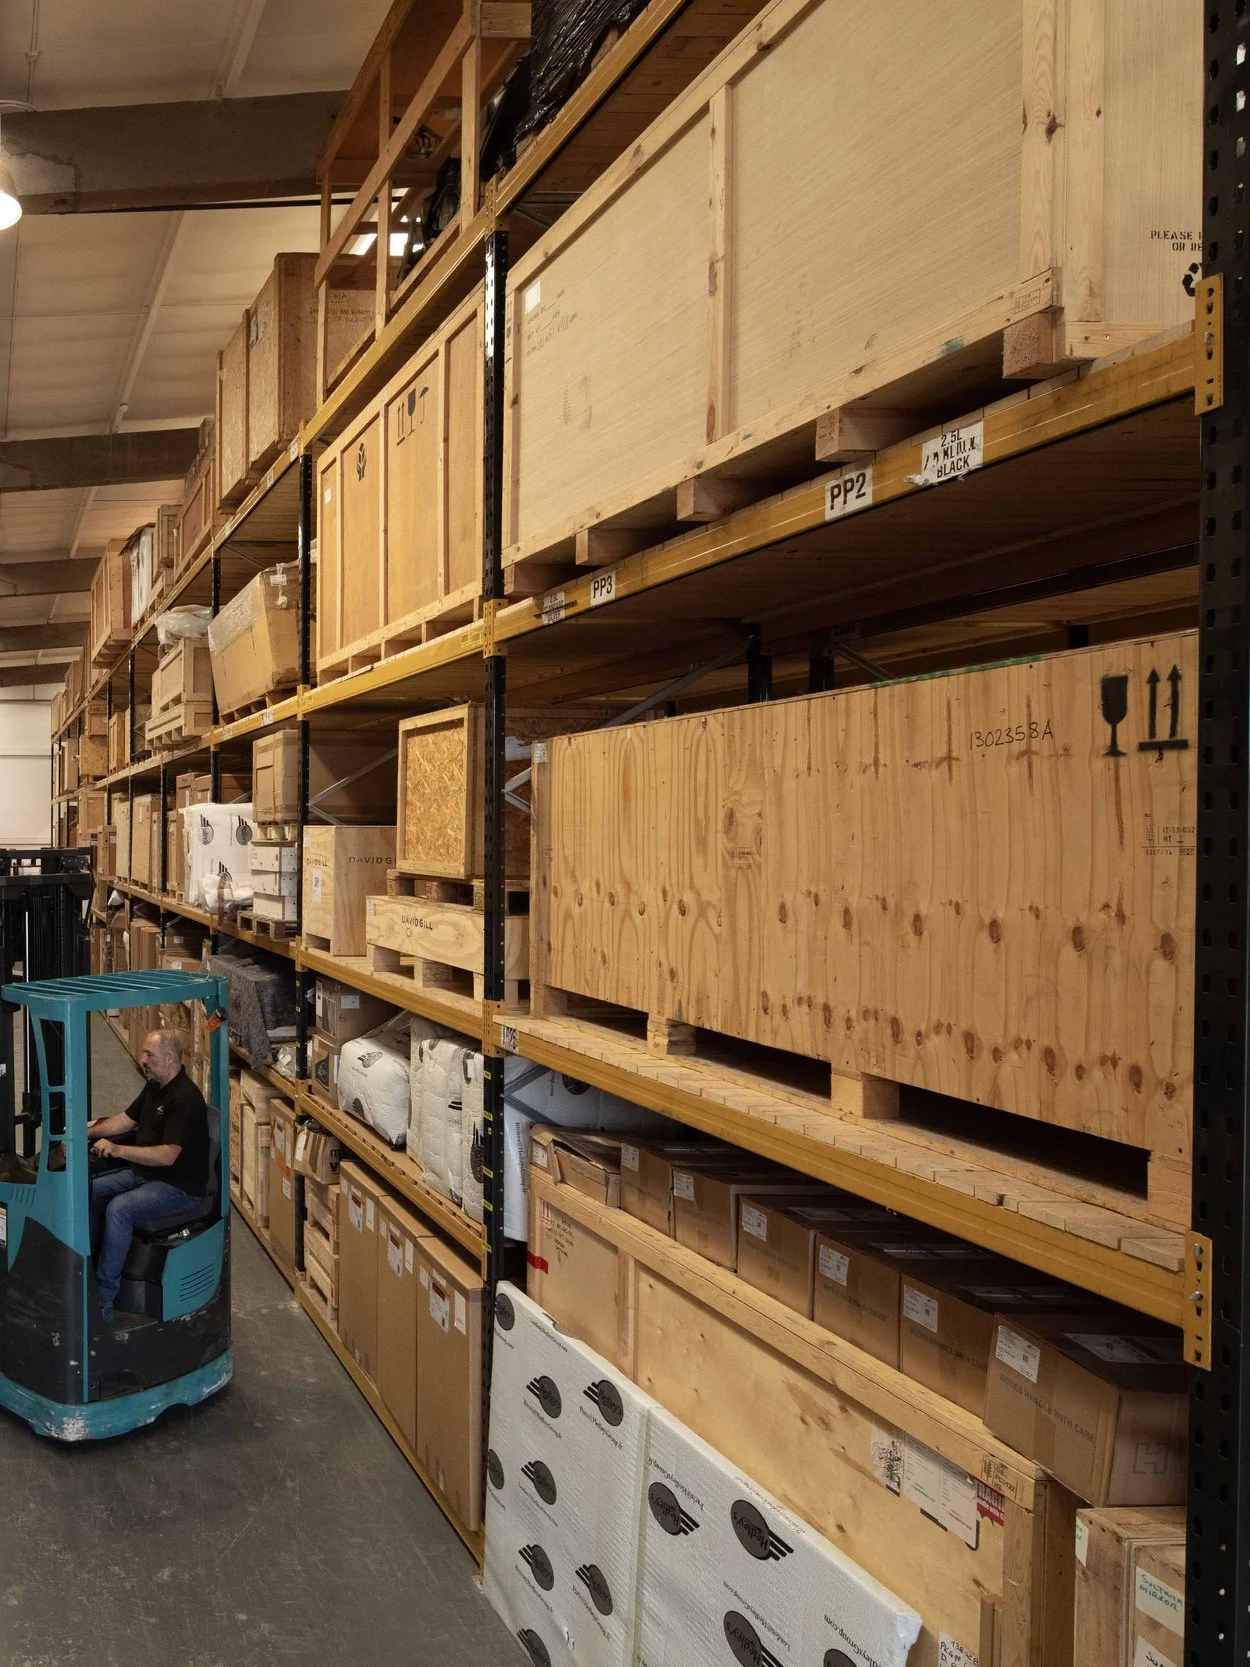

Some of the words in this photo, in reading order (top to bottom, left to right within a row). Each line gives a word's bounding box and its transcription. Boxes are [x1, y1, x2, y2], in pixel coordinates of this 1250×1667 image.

[1150, 230, 1193, 240] PLEASE
[1172, 242, 1186, 252] OR
[940, 428, 964, 448] 2.5L
[937, 454, 971, 479] BLACK
[830, 472, 867, 511] PP2
[593, 575, 613, 599] PP3
[970, 719, 1054, 751] 1302358A
[348, 856, 383, 865] DAVID
[999, 1372, 1023, 1395] BOOKS
[1023, 1389, 1052, 1415] HANDLE
[1053, 1411, 1073, 1429] WITH
[1074, 1423, 1095, 1443] CARE
[733, 1510, 769, 1551] Hedley's
